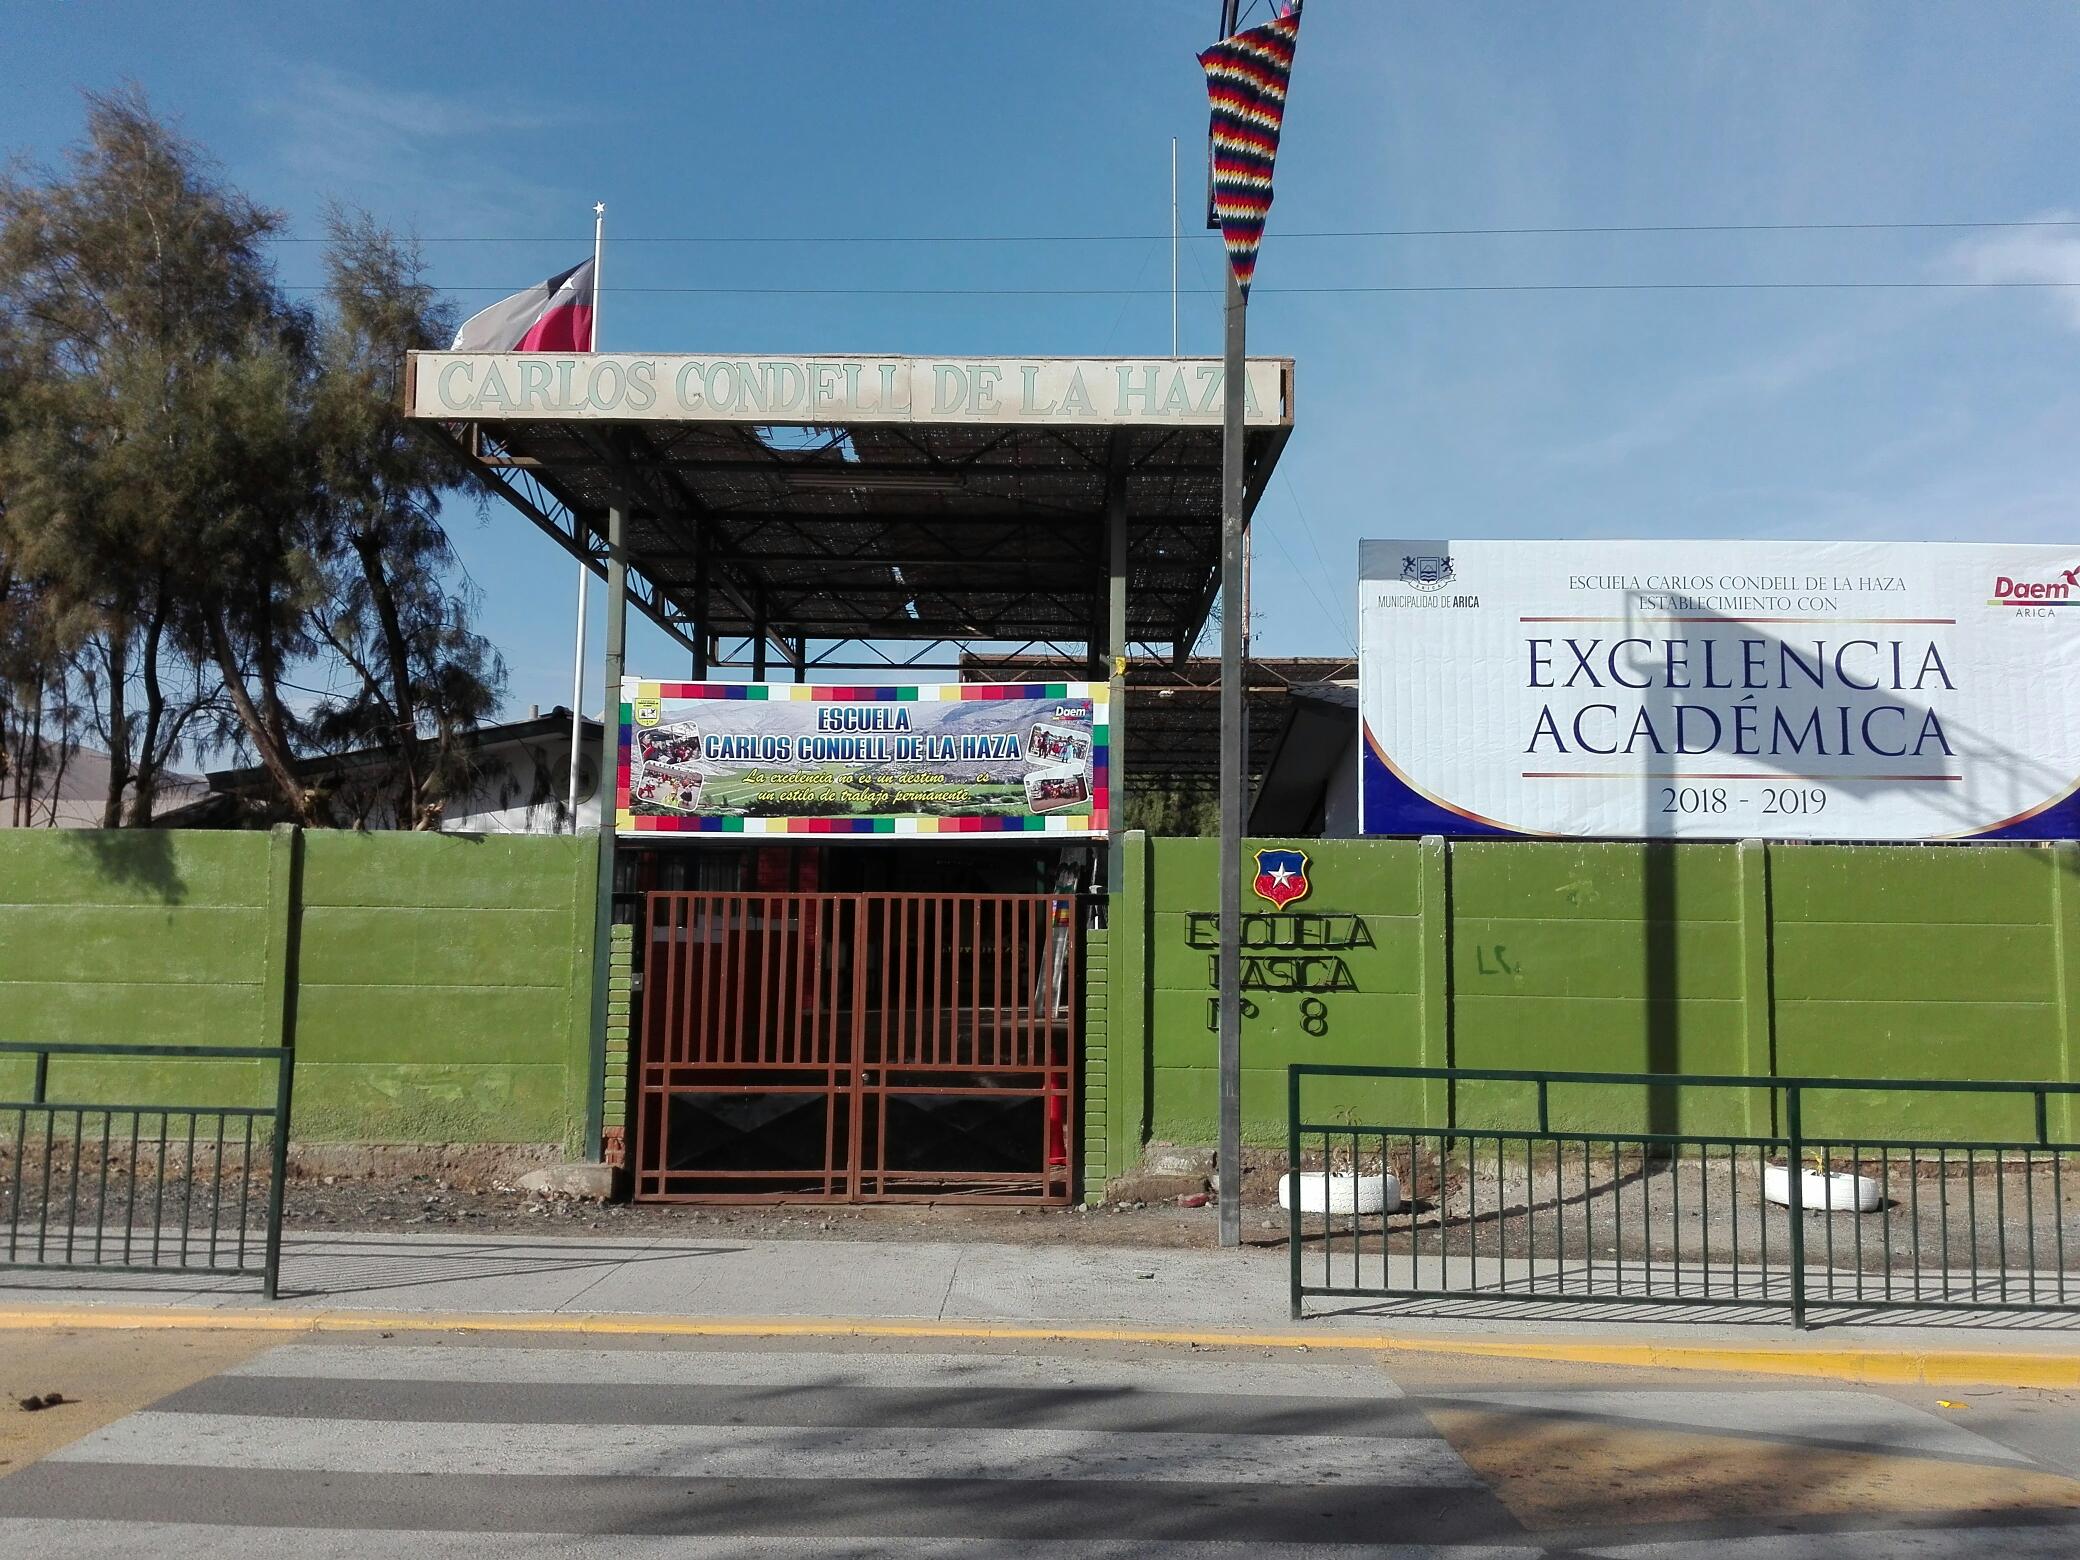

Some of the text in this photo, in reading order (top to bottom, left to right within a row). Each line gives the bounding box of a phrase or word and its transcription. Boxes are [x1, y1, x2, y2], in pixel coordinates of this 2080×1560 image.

[437, 360, 656, 412] CARLOS
[675, 361, 912, 415] CONDELL
[930, 364, 1002, 415] DE
[1020, 365, 1098, 417] LA
[1569, 575, 1906, 591] ESCUELA CARLOS CONDELL DE LA HAZA
[1994, 576, 2069, 598] Daem
[1378, 595, 1479, 608] MUNICIPALIDAD DE ARICA
[1639, 596, 1838, 611] ESTABLECIMIENTO CON
[2015, 608, 2056, 618] ARICA
[1526, 639, 1957, 690] EXCELENCIA
[817, 706, 912, 732] ESCUELA
[1055, 705, 1086, 717] Daem
[1523, 695, 1957, 756] ACADÉMICA
[704, 734, 1022, 762] CARLOS CONDELL DE LA HAZA
[742, 768, 766, 783] La
[770, 769, 834, 784] excelencia
[837, 773, 854, 784] no
[858, 773, 872, 784] es
[877, 773, 894, 784] un
[898, 771, 945, 784] destino
[976, 772, 990, 783] es
[757, 786, 972, 806] un estilo de trabajo permanente.
[1661, 787, 1728, 814] 2018
[1761, 788, 1828, 814] 2019
[1299, 997, 1328, 1037] 8
